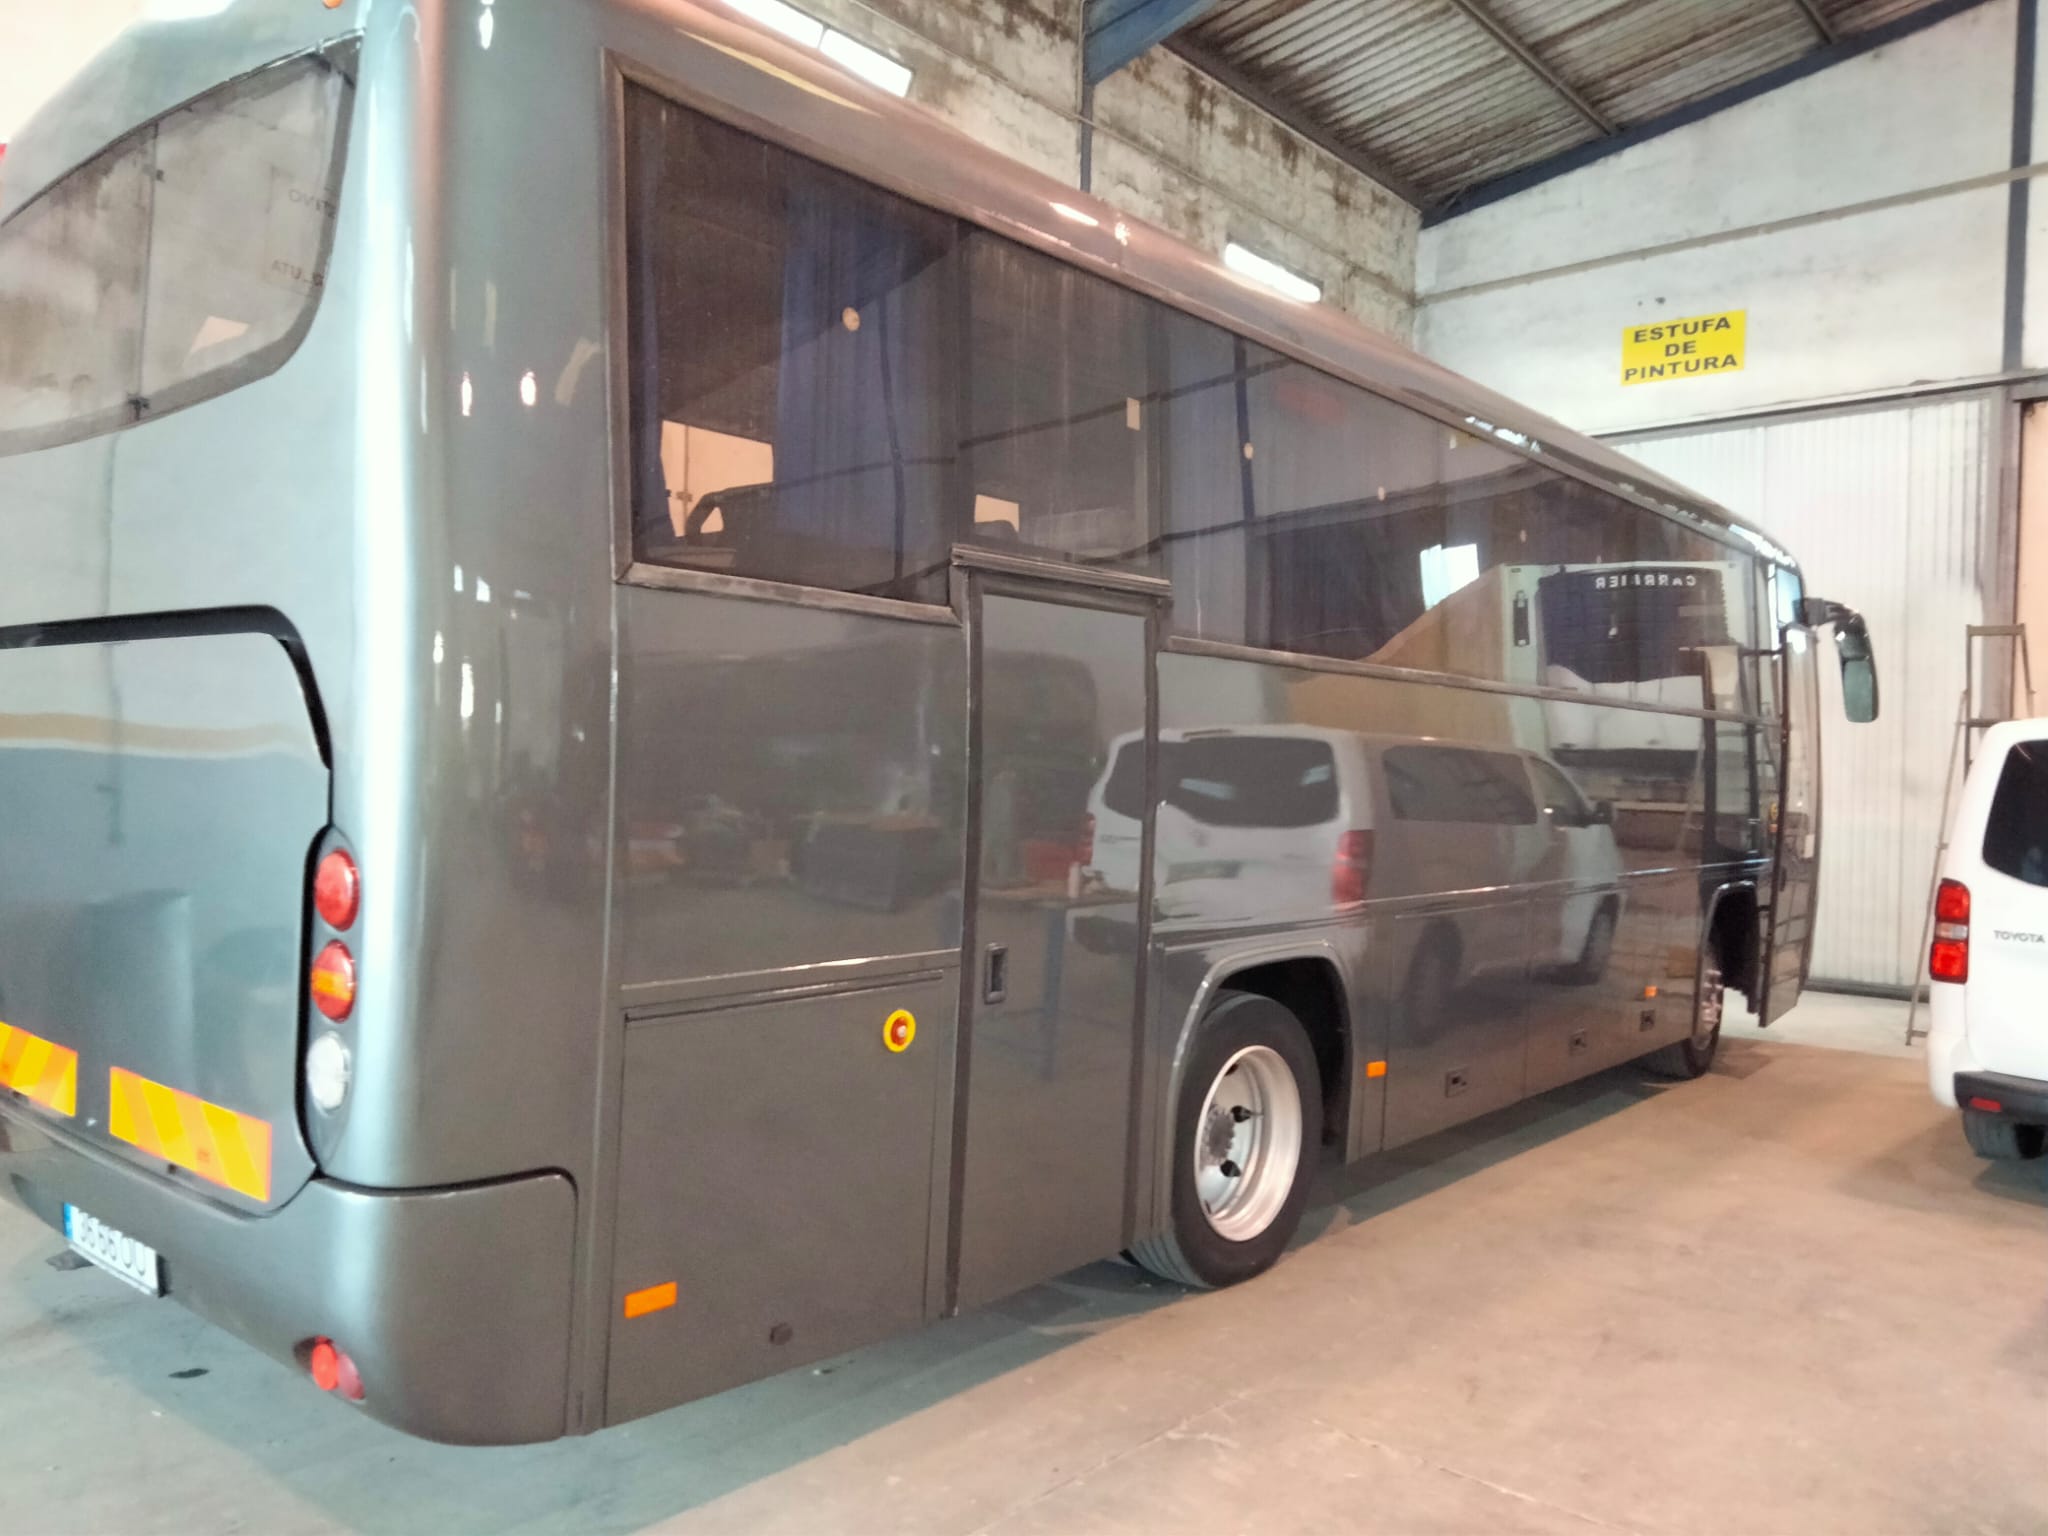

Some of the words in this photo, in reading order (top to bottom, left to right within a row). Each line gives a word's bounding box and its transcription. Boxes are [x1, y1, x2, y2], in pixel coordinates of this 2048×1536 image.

[1633, 317, 1731, 343] ESTUFA
[1665, 340, 1697, 357] DE
[1624, 354, 1737, 381] PINTURA
[1993, 930, 2046, 944] TOYOTA
